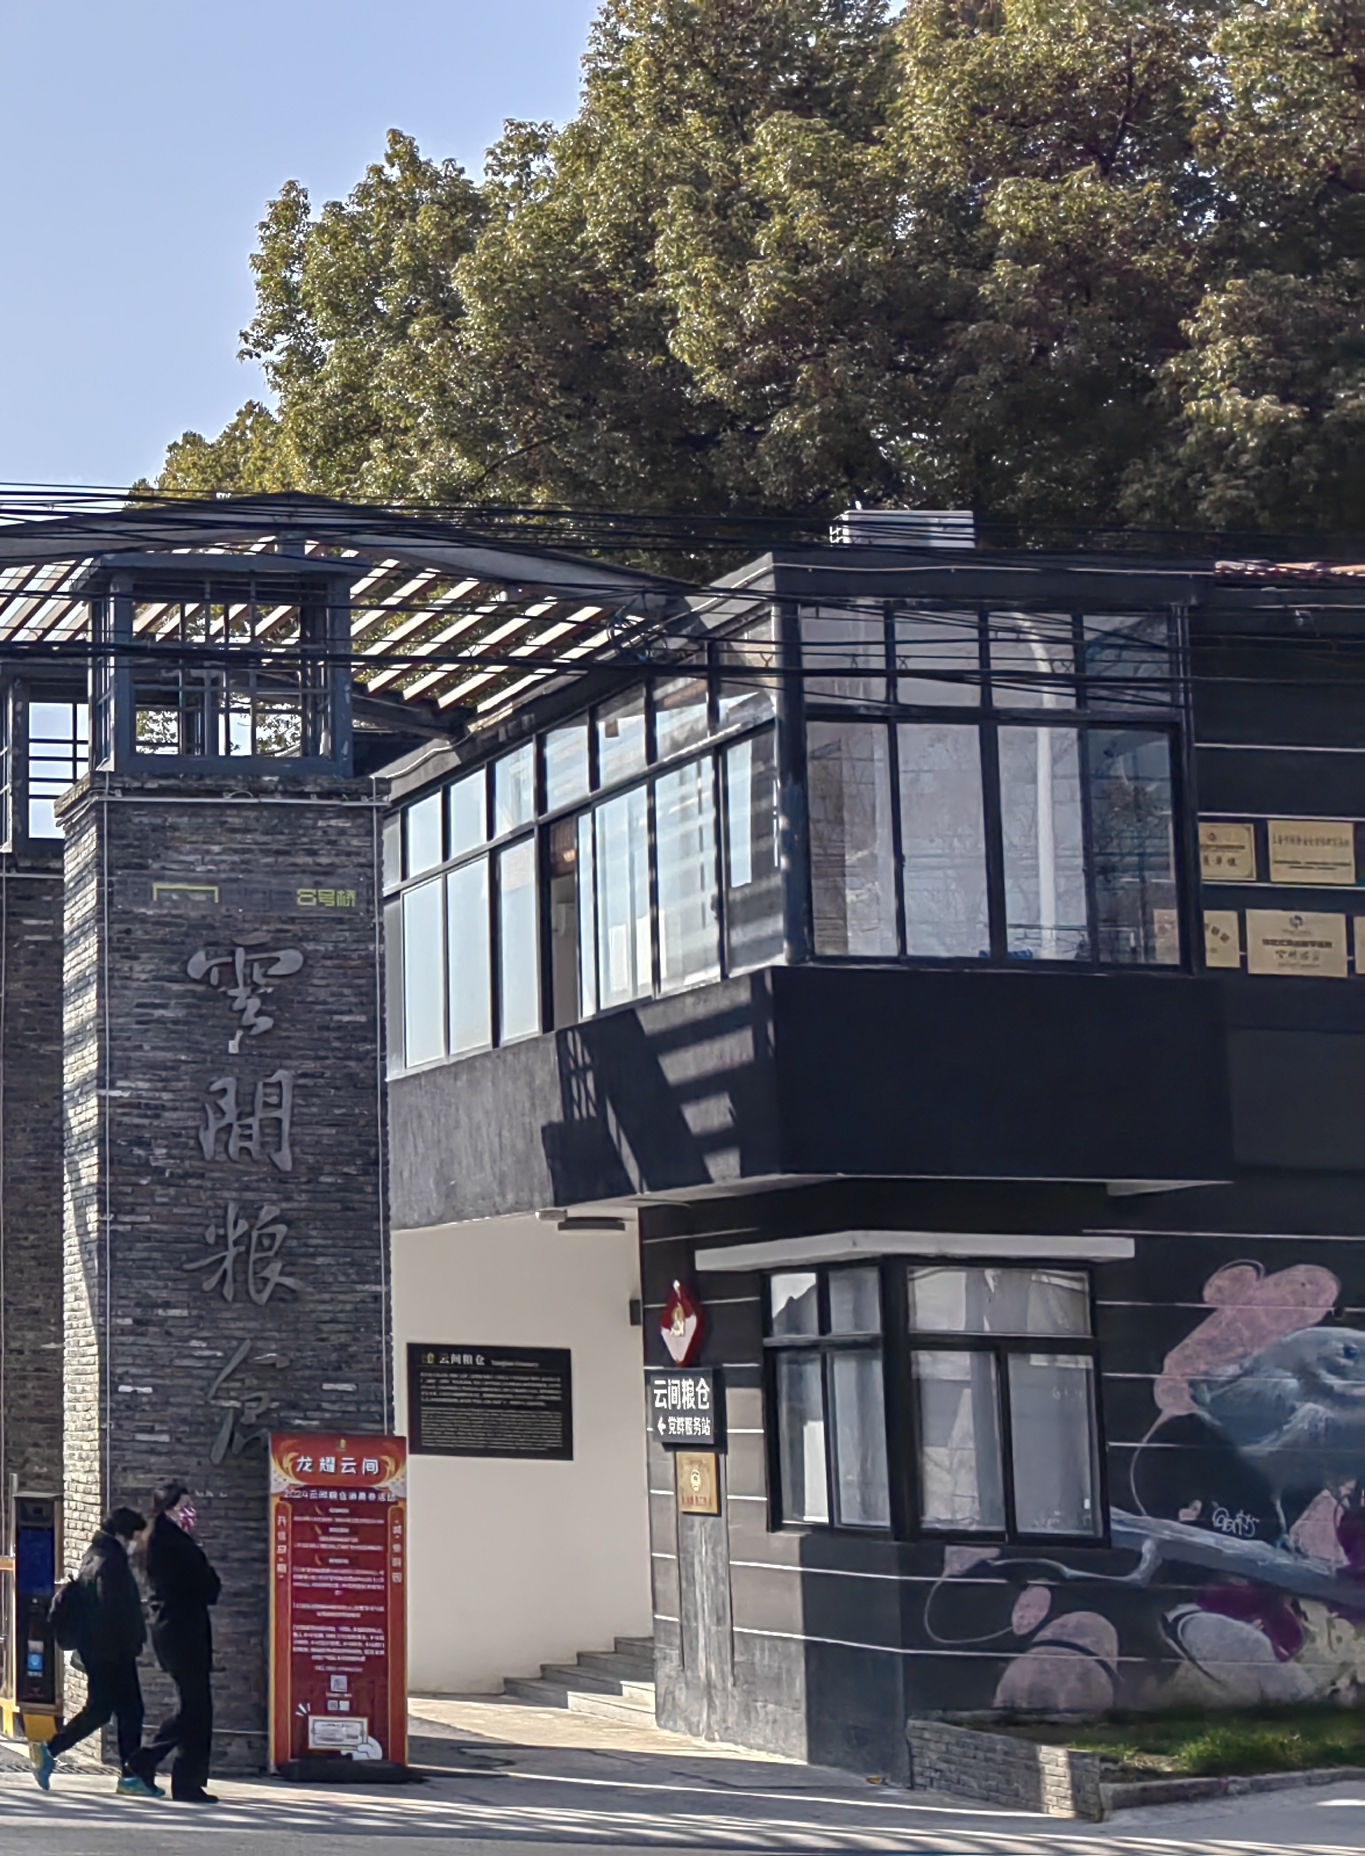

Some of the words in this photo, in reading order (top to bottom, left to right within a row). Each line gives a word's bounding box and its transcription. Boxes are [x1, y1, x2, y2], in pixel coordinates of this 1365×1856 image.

[653, 1378, 710, 1410] 云间粮仓
[667, 1416, 711, 1436] 党群服务站
[296, 1456, 379, 1475] 龙耀云间
